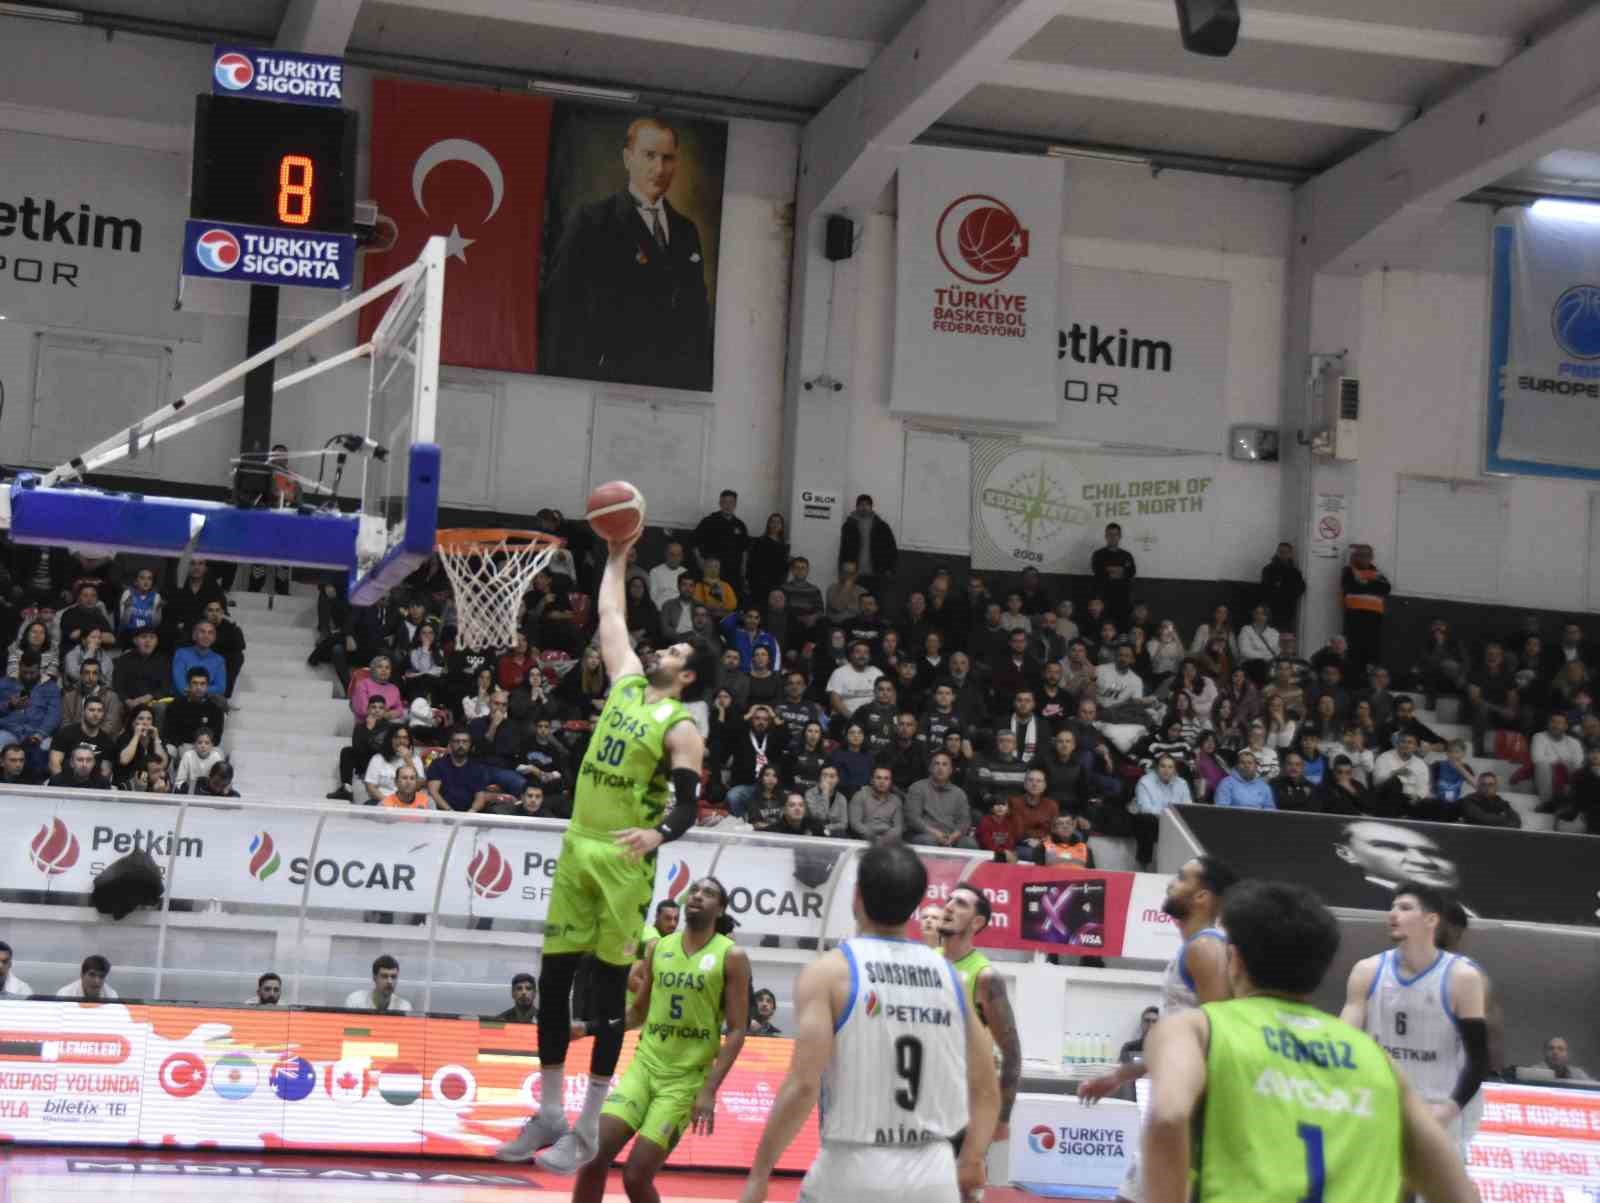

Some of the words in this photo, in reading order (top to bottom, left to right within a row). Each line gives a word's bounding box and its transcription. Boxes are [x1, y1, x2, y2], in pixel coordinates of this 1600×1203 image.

[278, 155, 313, 224] 8
[0, 196, 142, 252] etkim
[0, 255, 78, 287] OR
[933, 284, 1026, 312] TÜRKİYE
[933, 306, 1026, 326] BASKETBOL
[933, 320, 1026, 337] FEDERASYONU
[802, 491, 813, 501] G
[1082, 481, 1178, 500] CHILDREN
[1187, 478, 1212, 494] OF
[1093, 500, 1131, 517] THE
[1137, 495, 1203, 514] NORTH
[597, 735, 625, 767] 30
[92, 826, 203, 858] Petkim
[288, 857, 416, 891] SOCAR
[728, 886, 824, 918] OCAR
[1080, 934, 1102, 945] VISA
[670, 994, 683, 1019] 5
[1395, 1011, 1407, 1035] 6
[66, 1073, 140, 1094] YOLUNDA
[894, 1034, 923, 1112] 9
[43, 1099, 98, 1114] biletix
[1296, 1121, 1326, 1203] 1
[1522, 1149, 1588, 1176] KUPASI
